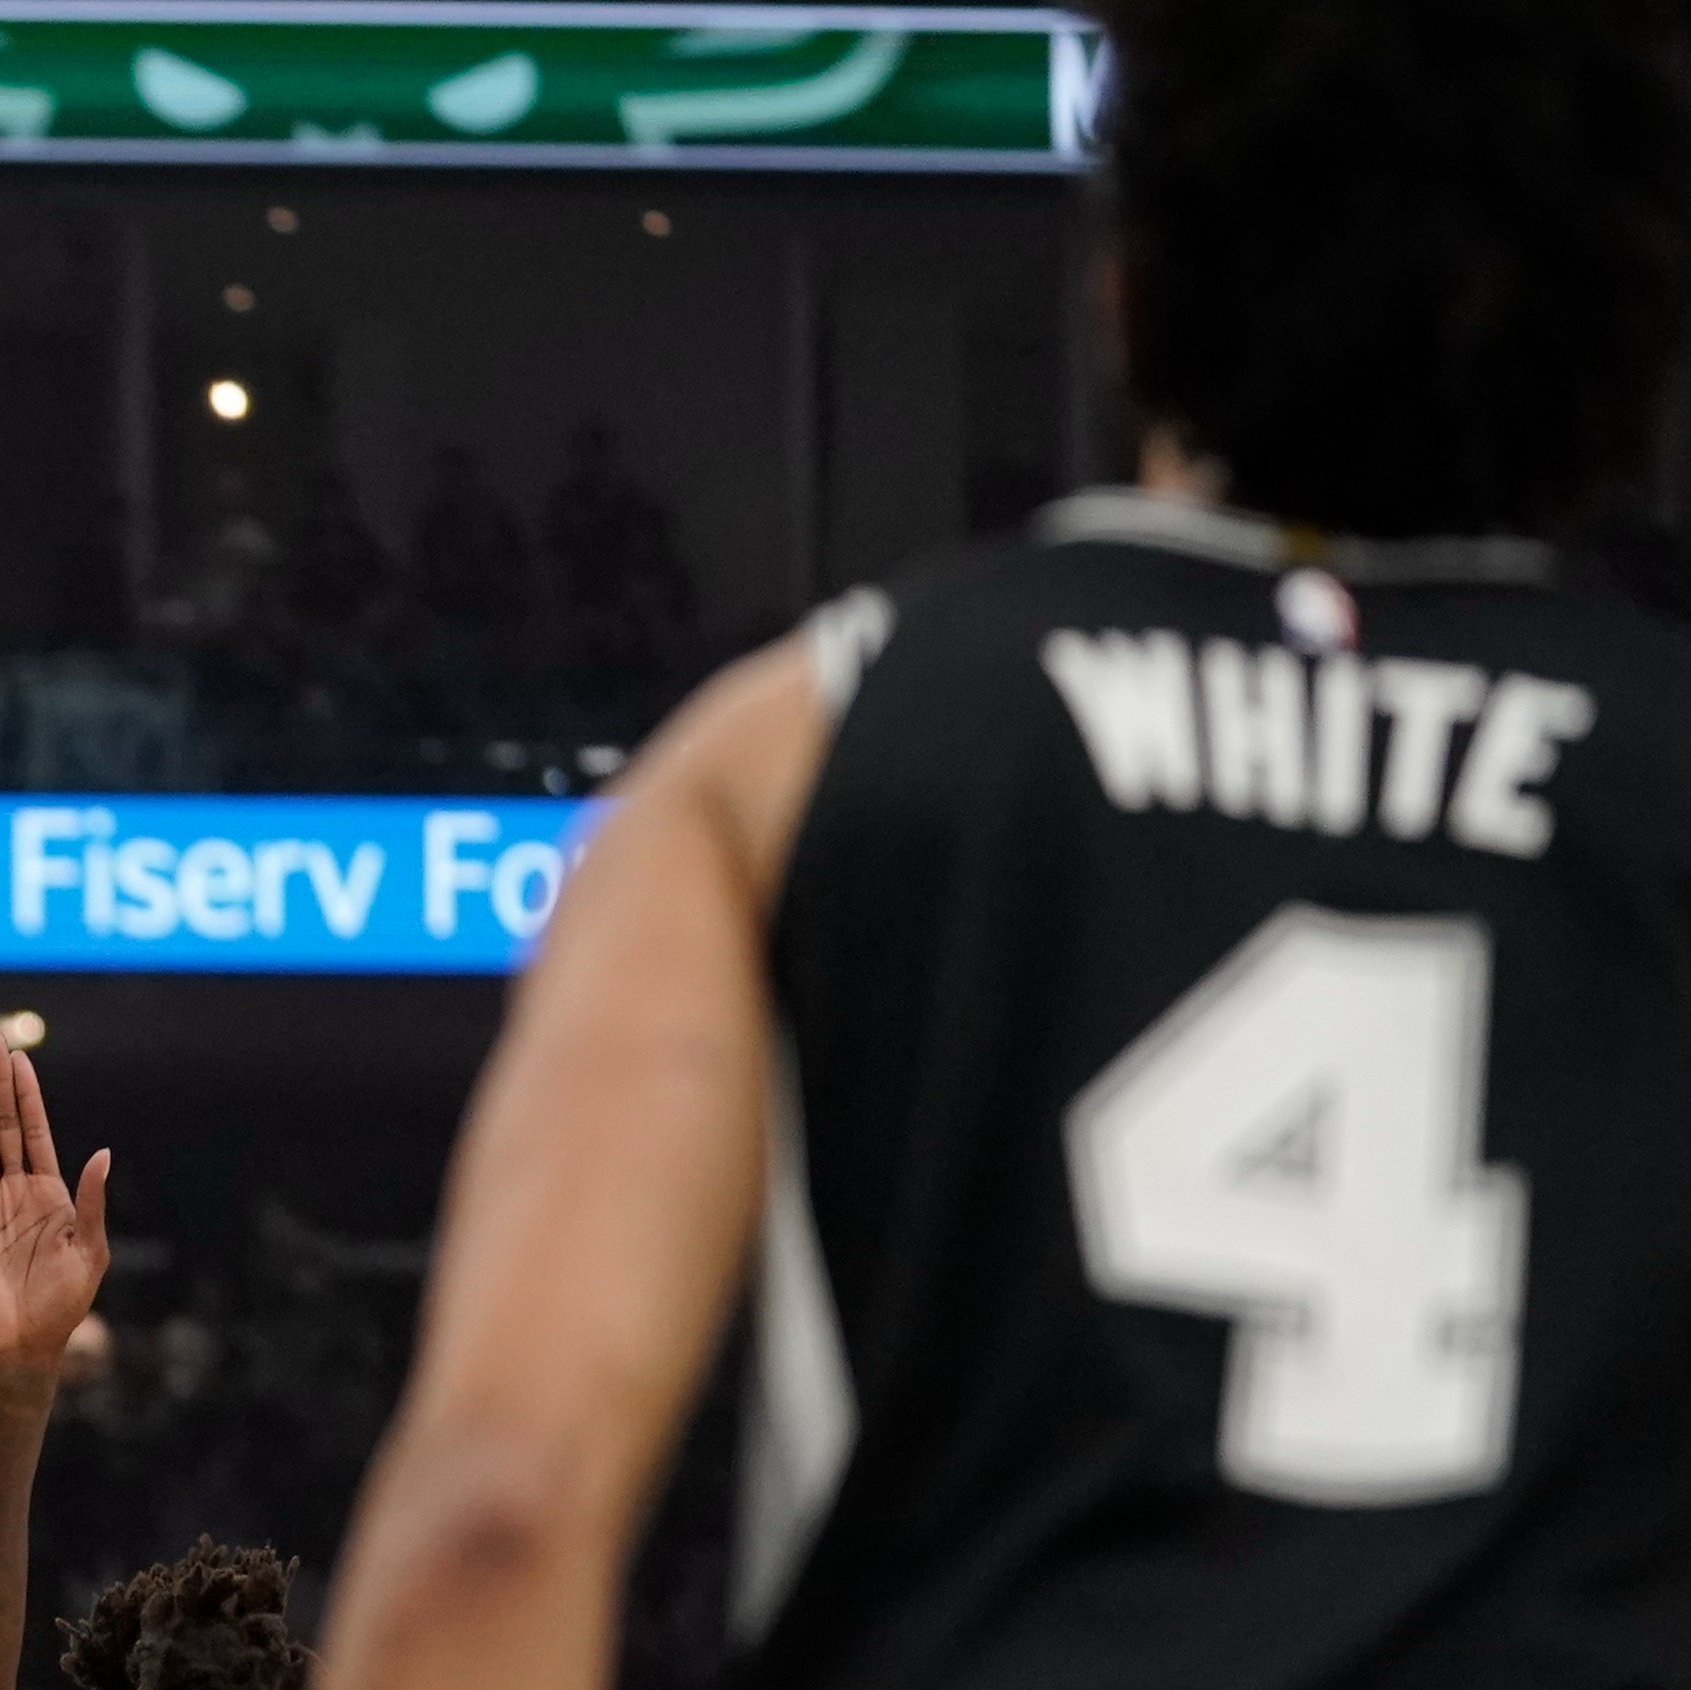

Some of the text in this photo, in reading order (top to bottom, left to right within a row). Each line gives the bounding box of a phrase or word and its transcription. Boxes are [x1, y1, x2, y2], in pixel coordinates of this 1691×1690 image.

[1039, 627, 1598, 859] WHITE
[17, 807, 387, 941] Fiserv
[422, 809, 585, 940] Fo
[1061, 899, 1532, 1509] 4
